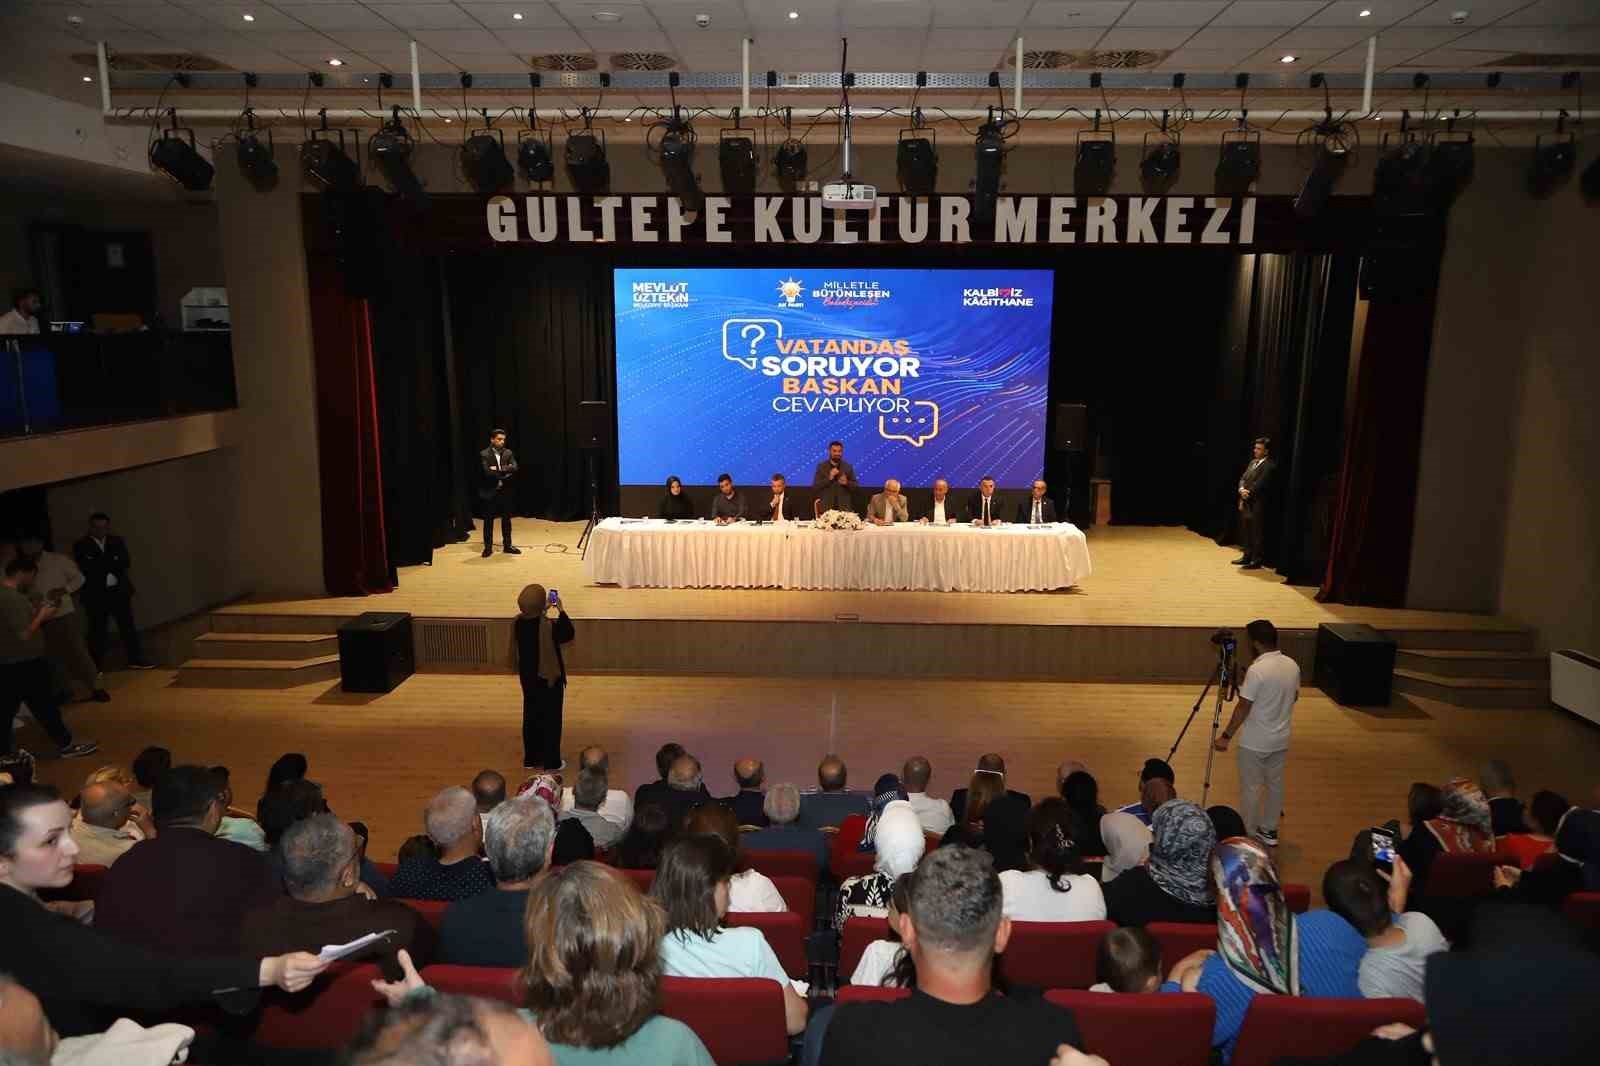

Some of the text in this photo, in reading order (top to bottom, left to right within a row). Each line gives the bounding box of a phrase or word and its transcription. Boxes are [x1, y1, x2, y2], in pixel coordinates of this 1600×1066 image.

[776, 339, 910, 357] VATANDAŞ
[761, 356, 920, 378] SORUYOR
[783, 378, 901, 396] BAŞKAN
[772, 396, 910, 413] CEVAPLIYOR
